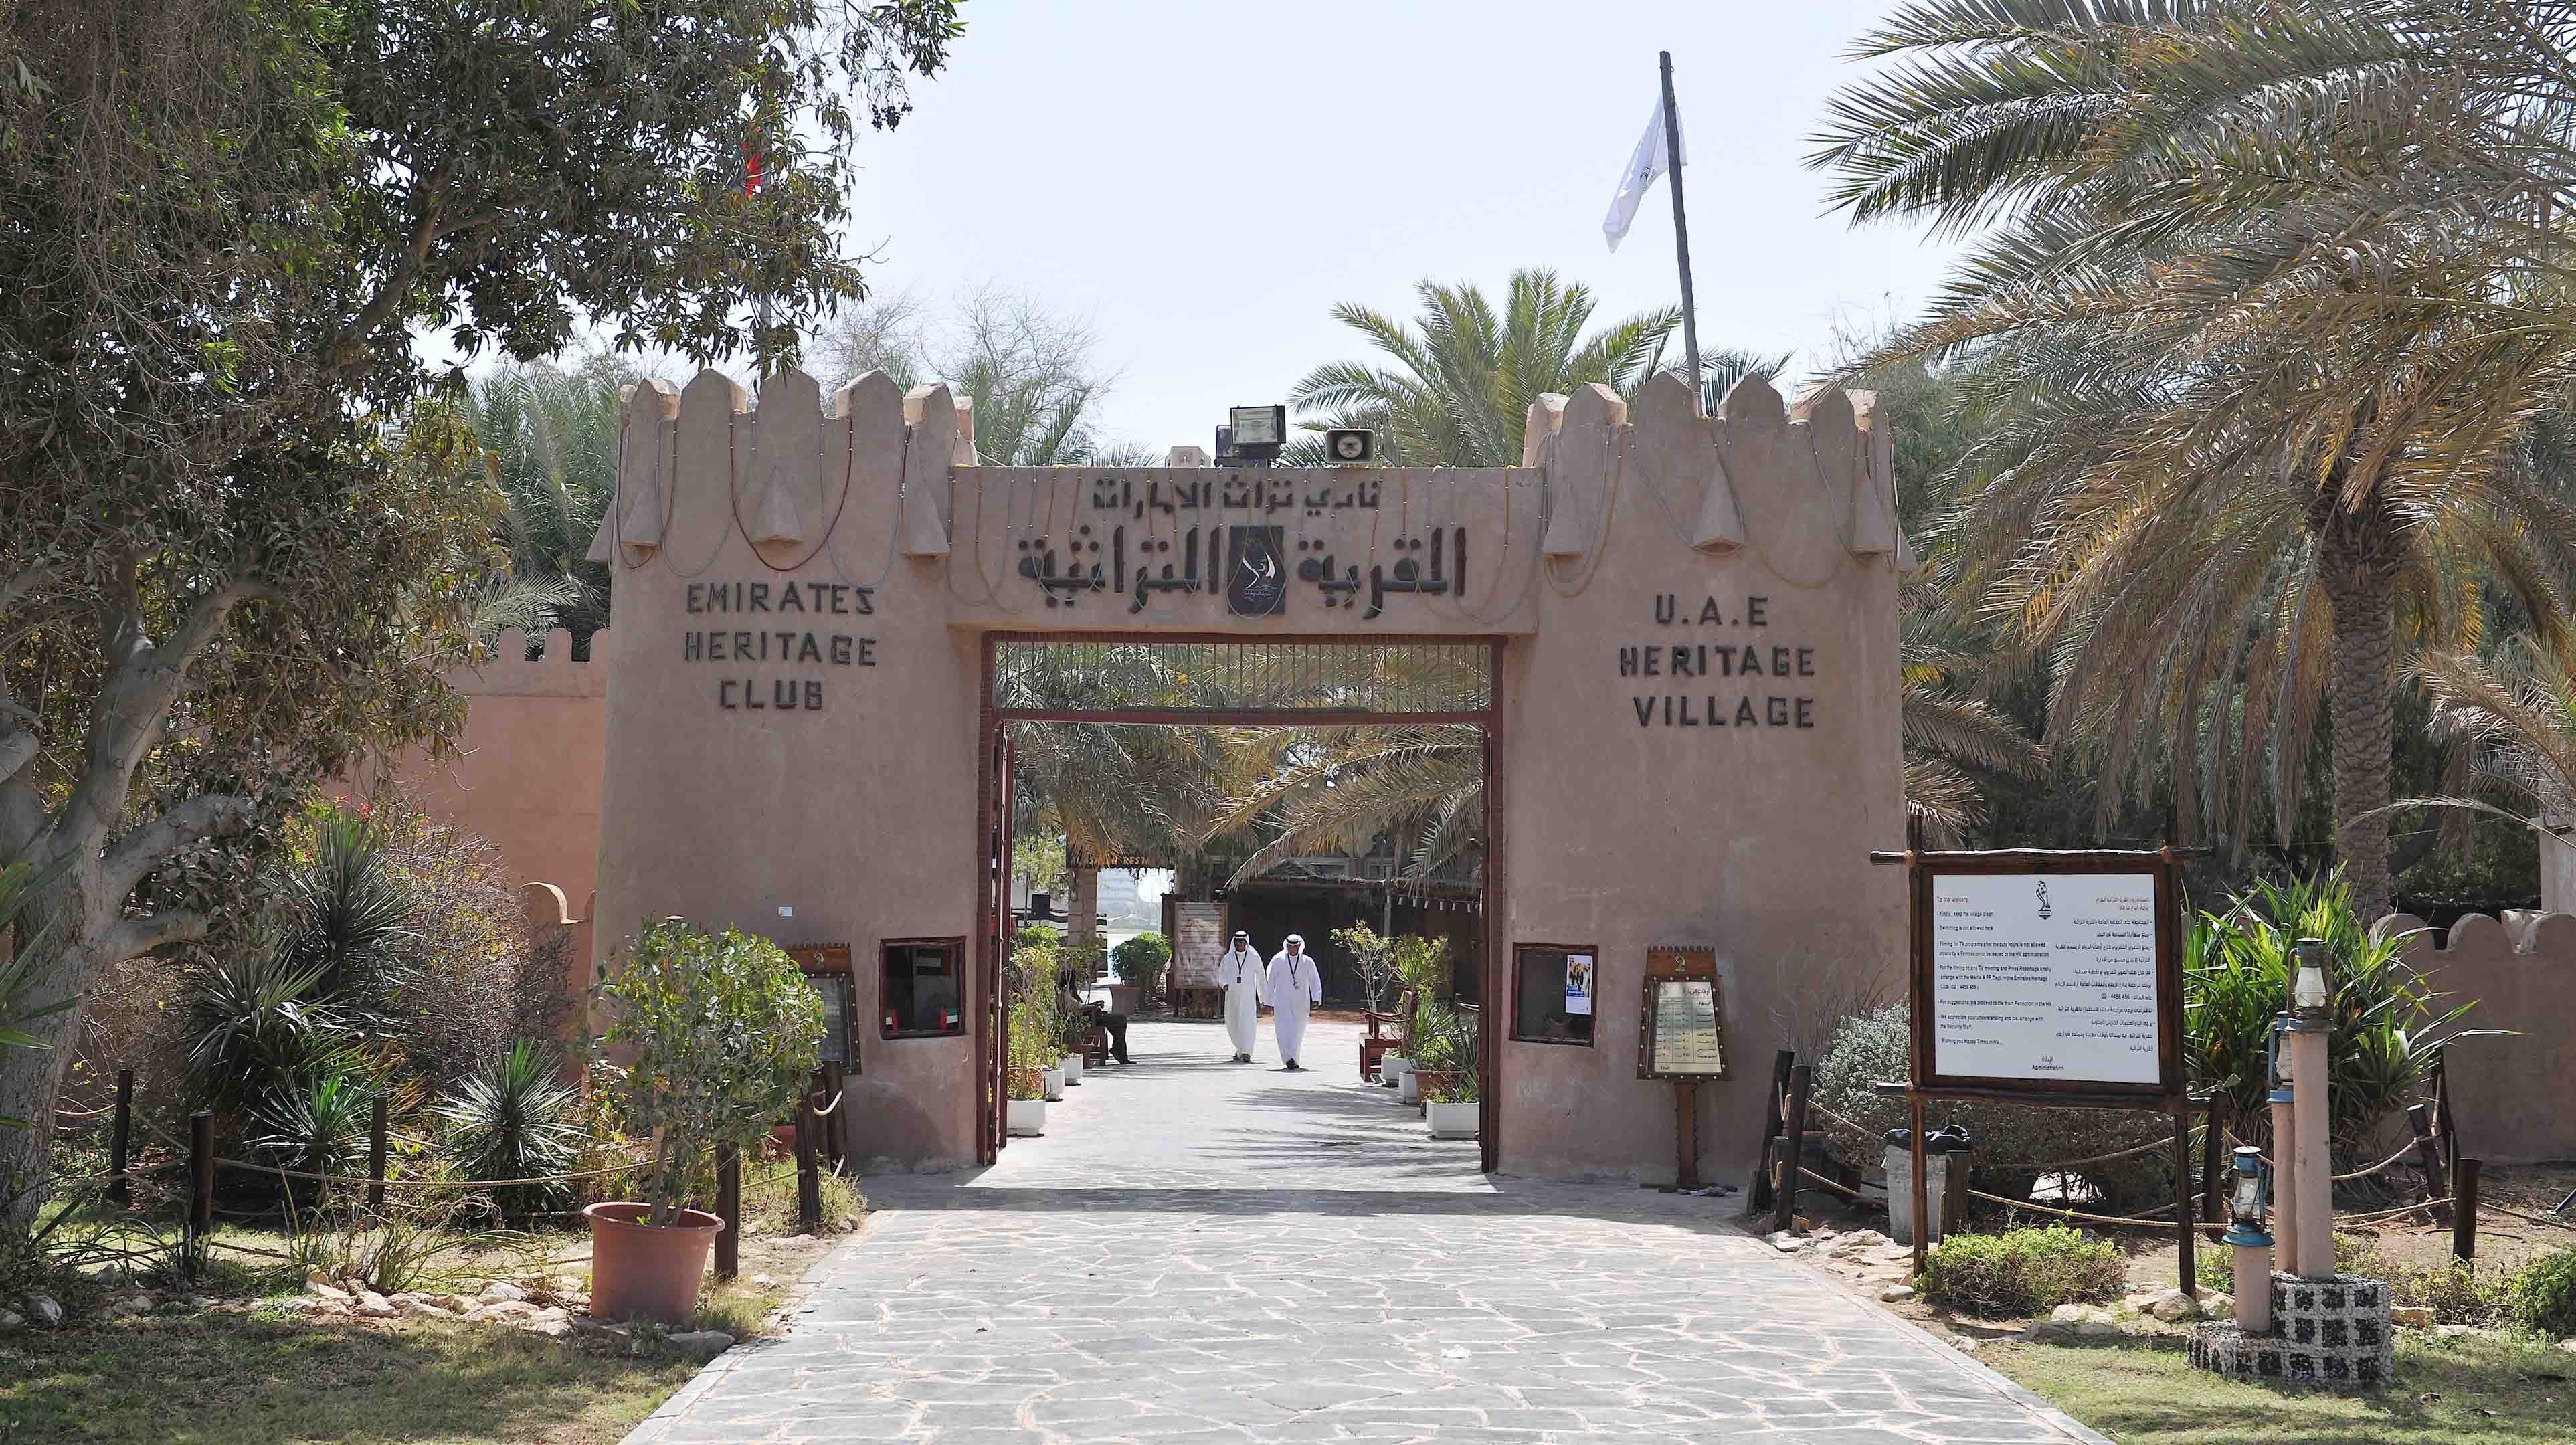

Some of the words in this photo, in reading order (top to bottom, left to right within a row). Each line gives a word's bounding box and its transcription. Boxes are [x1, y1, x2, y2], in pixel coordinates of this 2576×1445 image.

[1222, 474, 1293, 514] تراث
[1305, 480, 1378, 516] نادي
[1018, 524, 1222, 615] التراثية
[1298, 526, 1467, 620] القرية
[686, 581, 875, 615] EMIRATES
[1654, 594, 1769, 626] U.A.E
[684, 630, 878, 667] HERITAGE
[1619, 644, 1815, 677] HERITAGE
[719, 678, 824, 710] CLUB
[1633, 696, 1815, 729] VILLAGE
